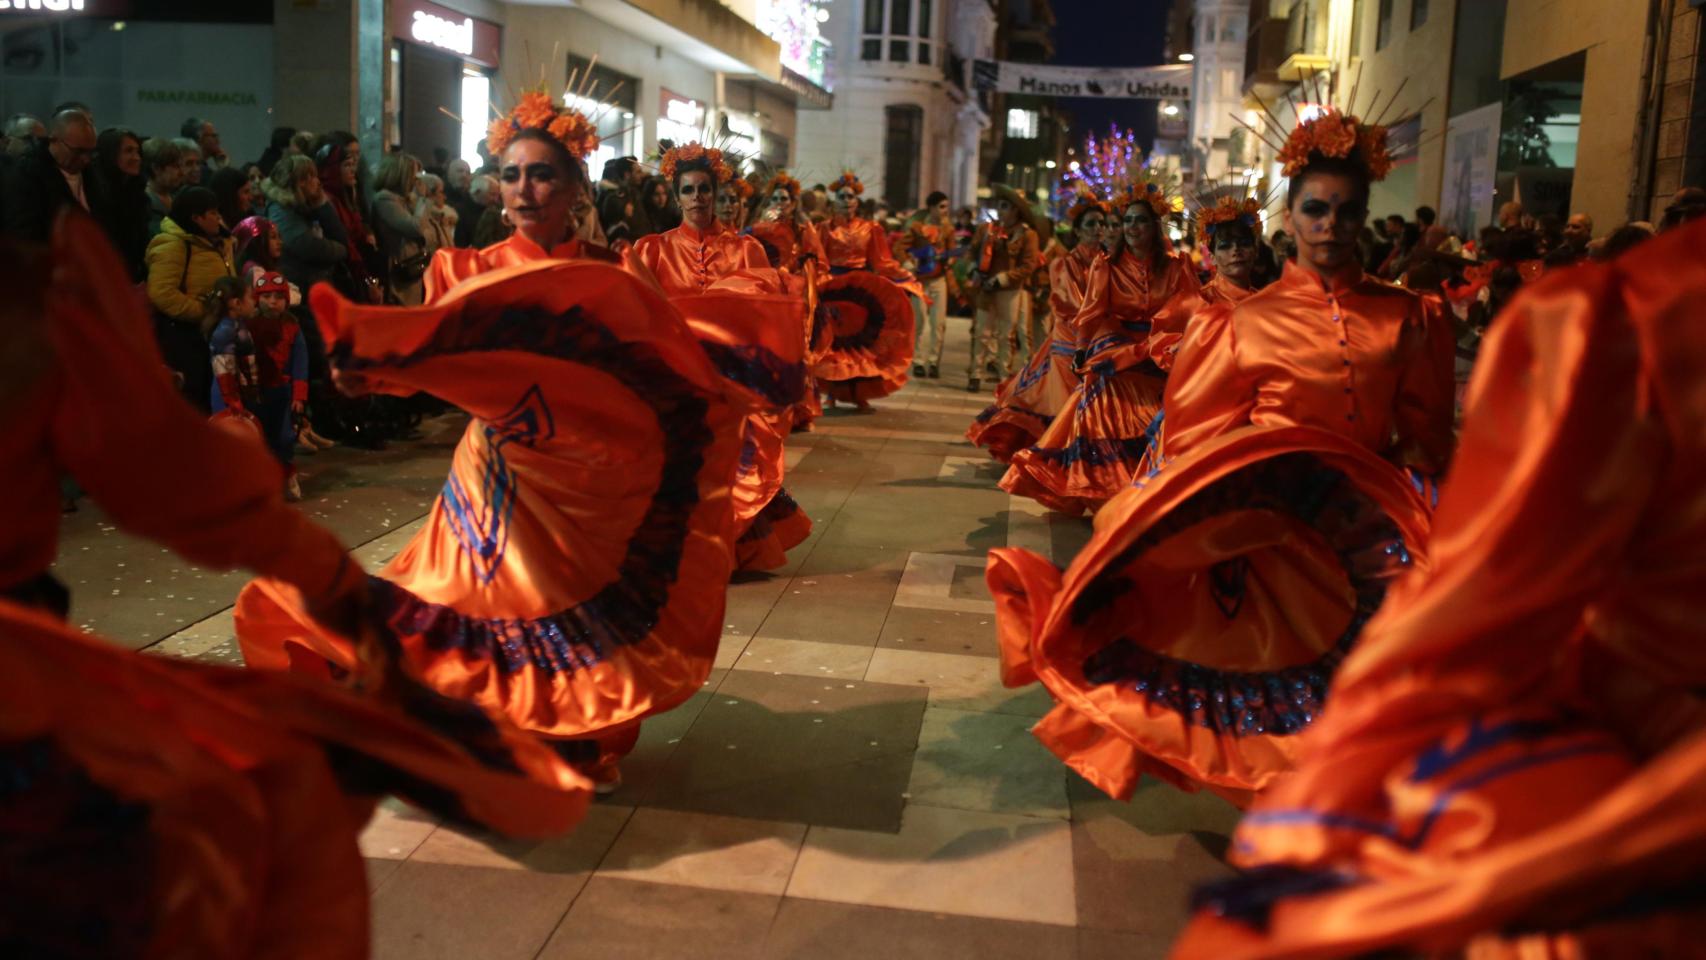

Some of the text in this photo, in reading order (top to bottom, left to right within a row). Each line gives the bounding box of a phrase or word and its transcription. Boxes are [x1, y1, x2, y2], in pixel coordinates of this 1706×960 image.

[1019, 77, 1190, 97] Manos Unidas
[137, 90, 257, 105] PARAFARMACIA
